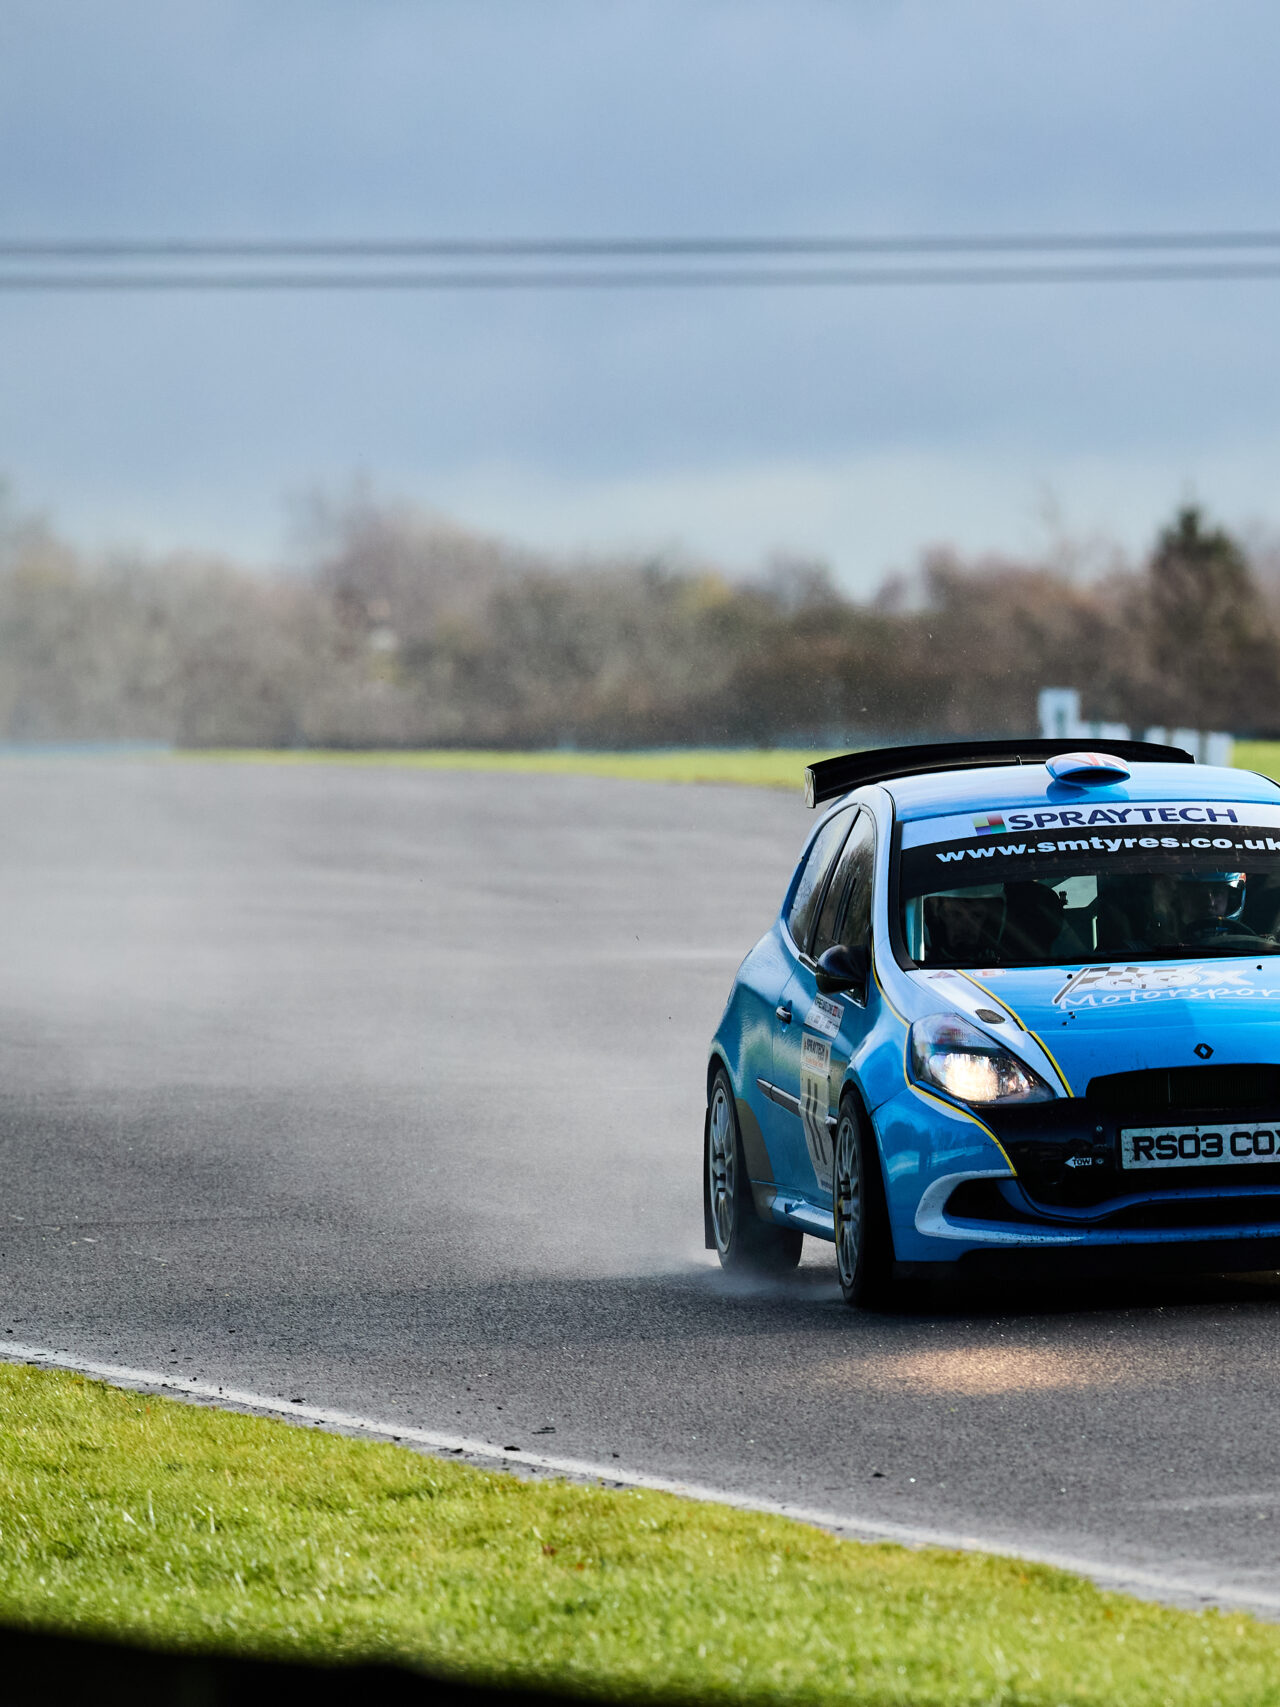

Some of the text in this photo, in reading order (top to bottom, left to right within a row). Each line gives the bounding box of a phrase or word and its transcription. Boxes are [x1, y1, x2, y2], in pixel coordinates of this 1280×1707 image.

[1009, 808, 1238, 830] SPRAYTECH
[1131, 1133, 1223, 1161] RS03
[1072, 1157, 1092, 1166] TOW
